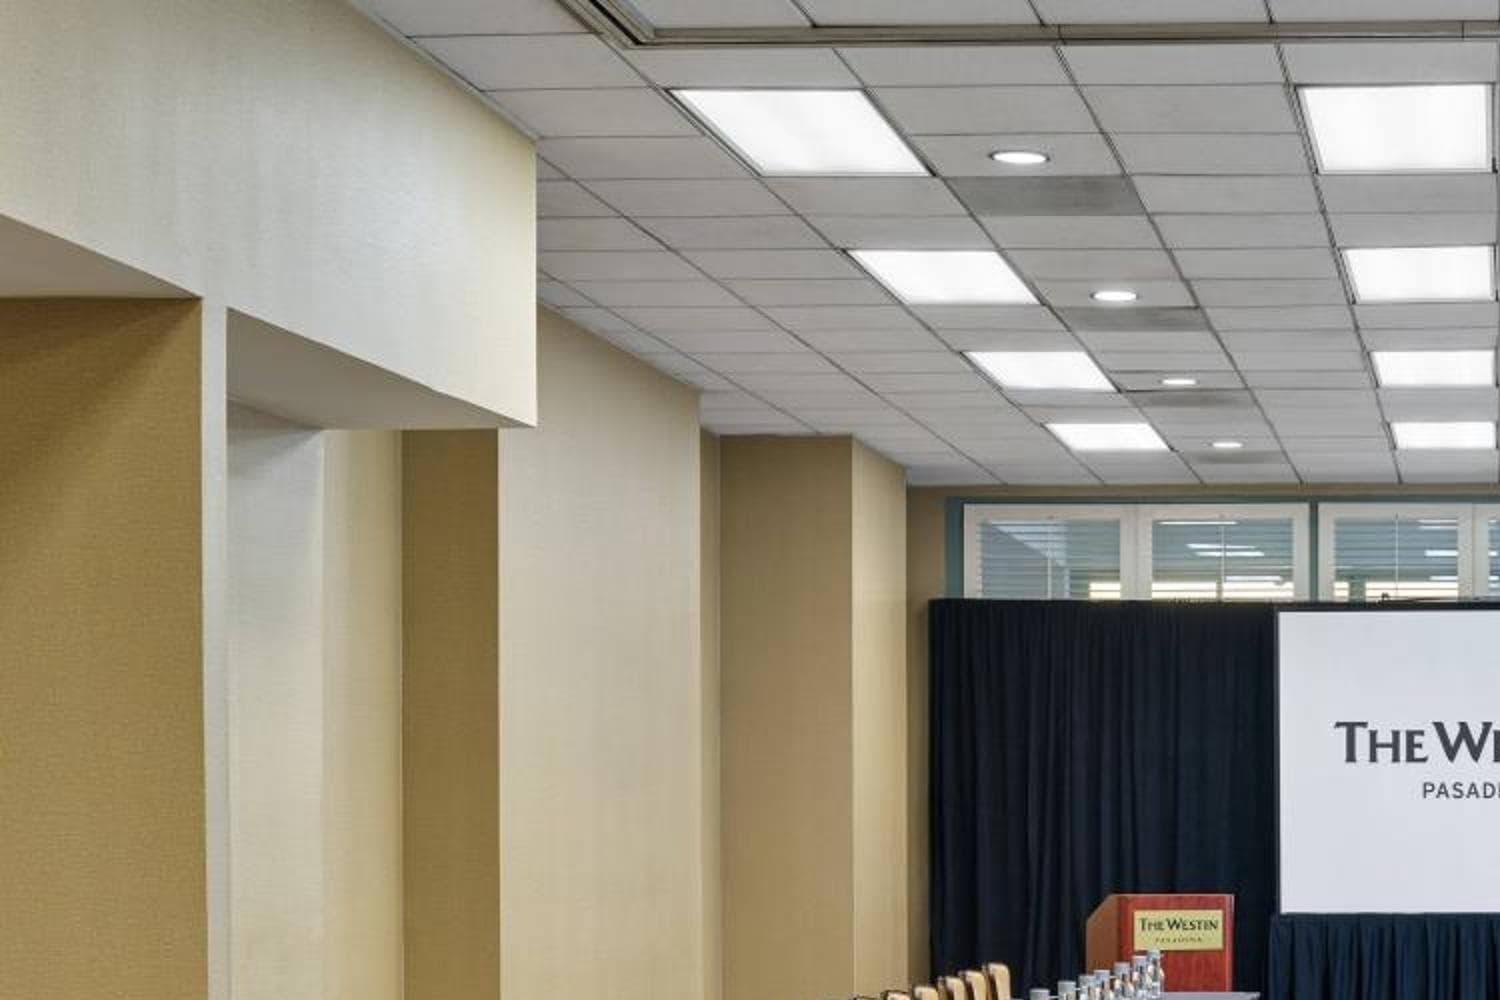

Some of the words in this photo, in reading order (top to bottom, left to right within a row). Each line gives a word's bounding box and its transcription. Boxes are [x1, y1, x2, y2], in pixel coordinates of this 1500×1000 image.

[1333, 721, 1429, 763] THE
[1138, 917, 1164, 932] THE
[1165, 917, 1219, 932] WESTIN
